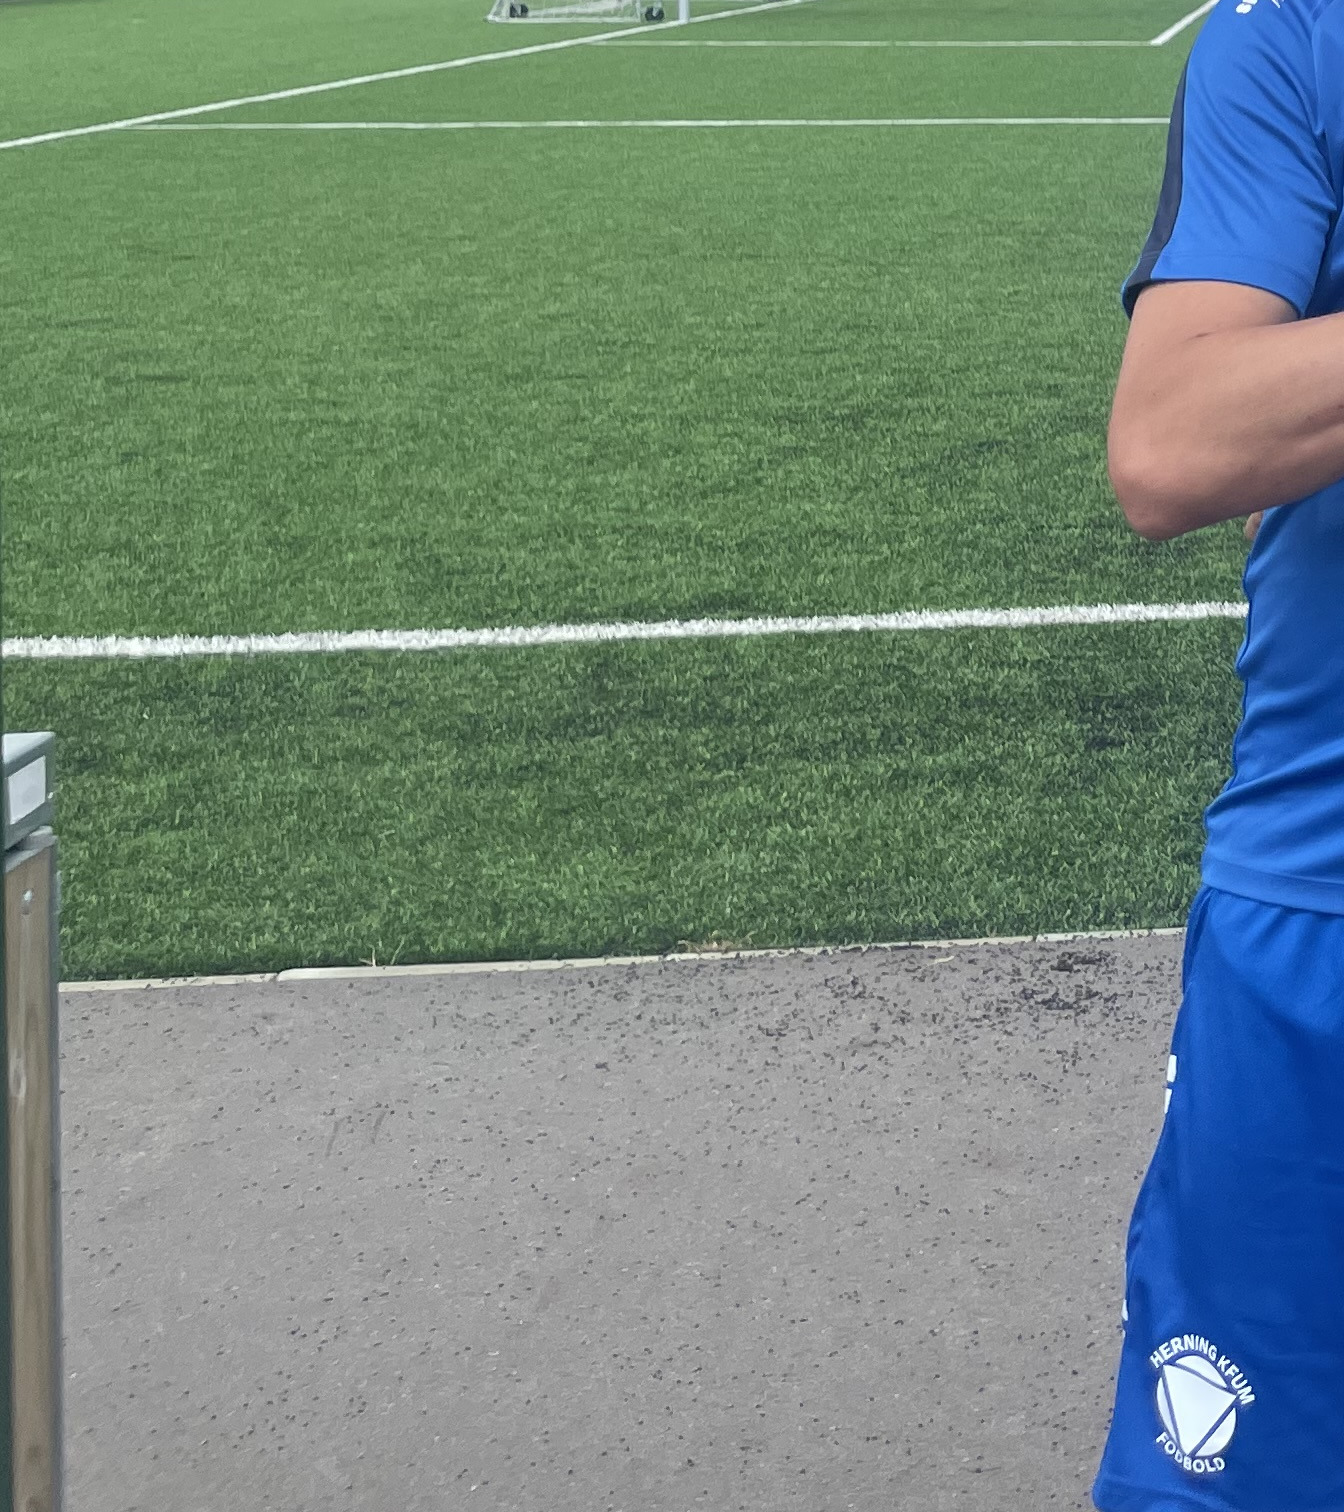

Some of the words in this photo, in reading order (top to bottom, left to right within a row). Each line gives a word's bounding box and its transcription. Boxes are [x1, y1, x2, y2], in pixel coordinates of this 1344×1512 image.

[1150, 1334, 1218, 1369] HERNING
[1216, 1354, 1256, 1405] KFUM
[1155, 1431, 1226, 1473] FODBOLD
